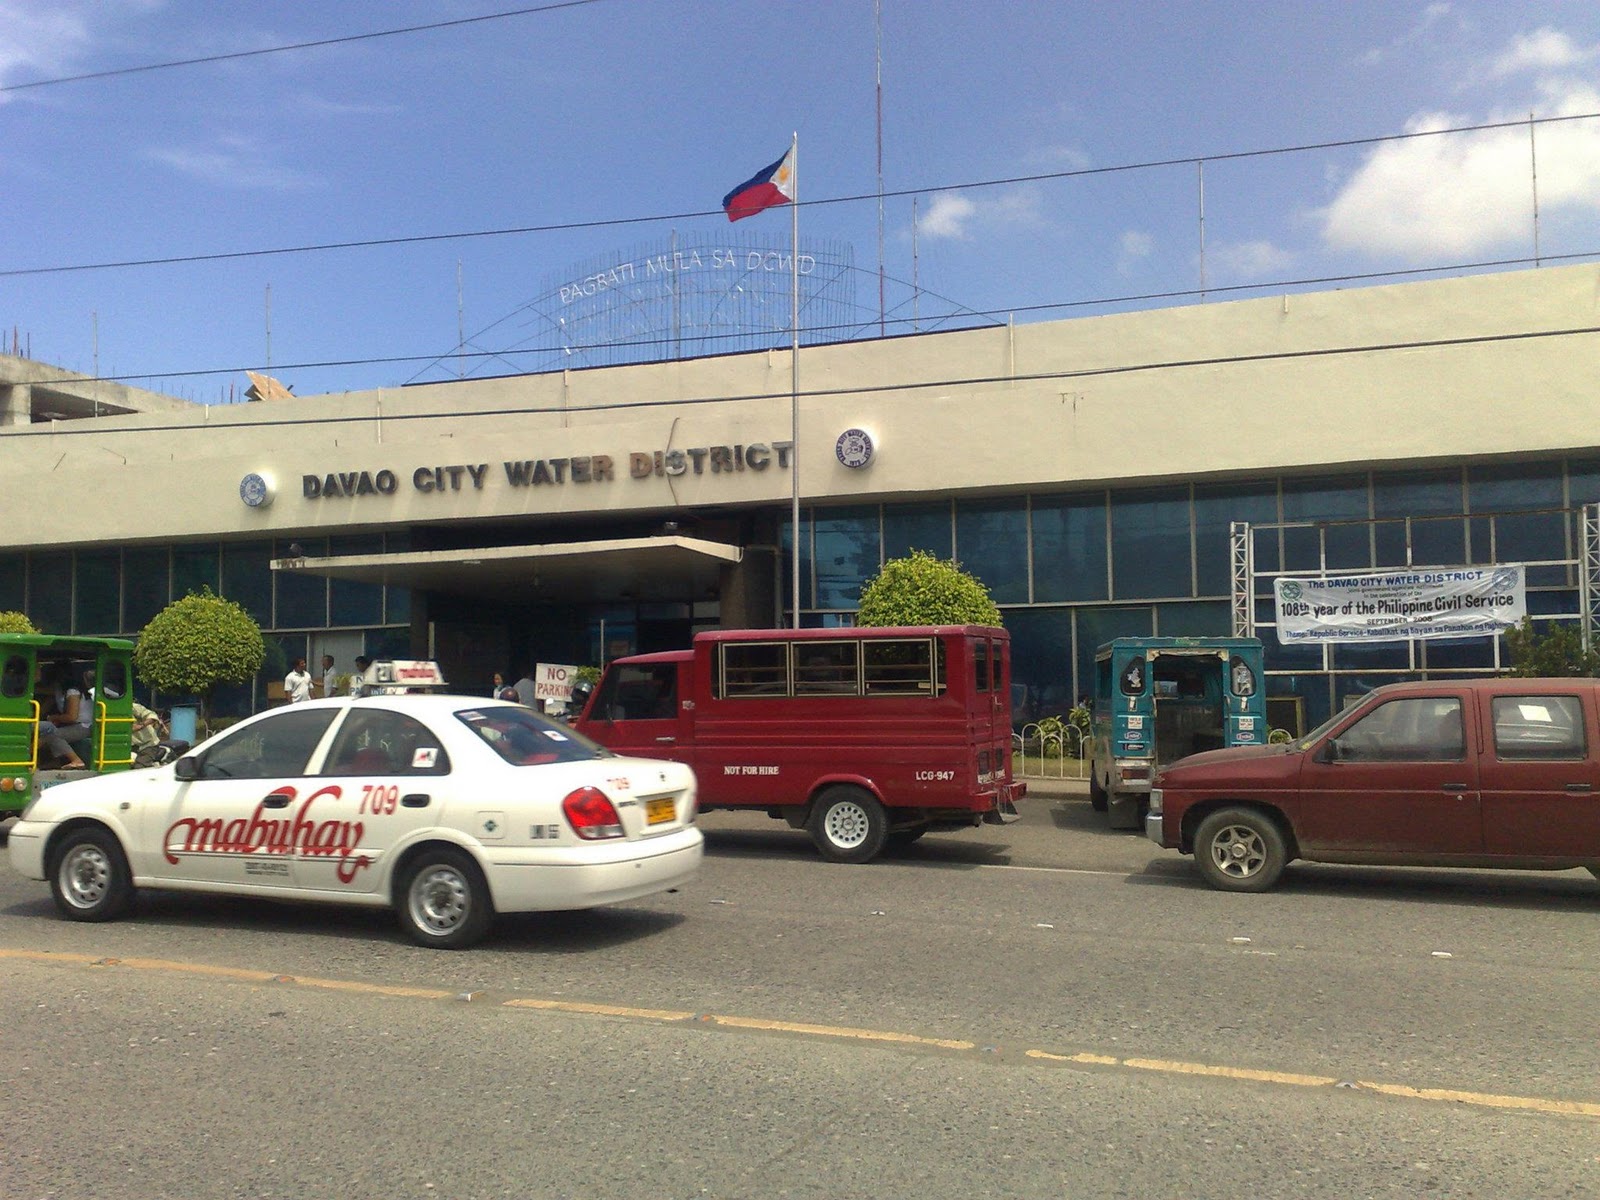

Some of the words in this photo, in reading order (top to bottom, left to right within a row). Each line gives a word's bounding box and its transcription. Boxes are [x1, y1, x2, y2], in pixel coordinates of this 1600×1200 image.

[647, 251, 703, 277] MULA
[712, 249, 736, 269] SA
[303, 469, 399, 499] DAVAO
[413, 464, 488, 494] CITY
[503, 454, 614, 487] WATER
[629, 440, 794, 479] DISTRICT
[1308, 580, 1325, 589] The
[1327, 578, 1359, 588] DAVAO
[1360, 577, 1382, 587] CITY
[1386, 575, 1420, 585] WATER
[1424, 571, 1484, 583] DISTRICT
[1281, 602, 1310, 617] 108th
[1313, 605, 1339, 619] year
[1341, 601, 1353, 614] of
[1355, 601, 1376, 615] the
[1377, 598, 1433, 616] Philippine
[1434, 595, 1462, 611] Civil
[1465, 591, 1514, 608] Service
[1366, 617, 1408, 625] SEPTEMBER
[547, 667, 567, 681] NO
[724, 766, 740, 775] NOT
[742, 766, 758, 775] FOR
[759, 766, 780, 775] HIRE
[915, 770, 955, 781] LCG-947
[358, 785, 399, 815] 709
